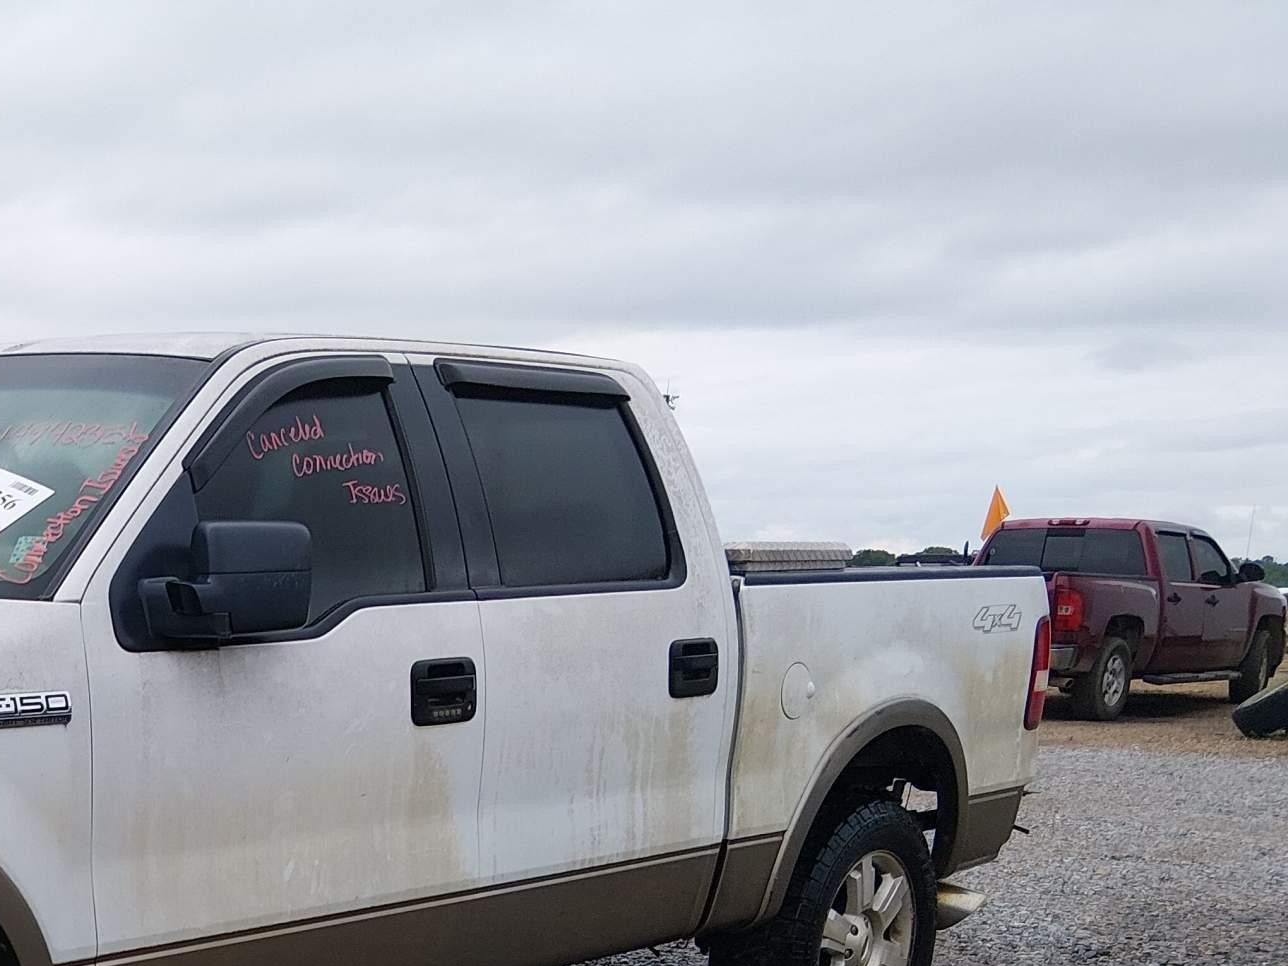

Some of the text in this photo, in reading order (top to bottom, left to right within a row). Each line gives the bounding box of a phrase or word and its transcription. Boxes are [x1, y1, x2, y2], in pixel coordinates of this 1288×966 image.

[246, 414, 325, 460] Canceled
[292, 443, 384, 477] Connection
[342, 479, 407, 504] Issues
[973, 604, 1022, 633] 4x4
